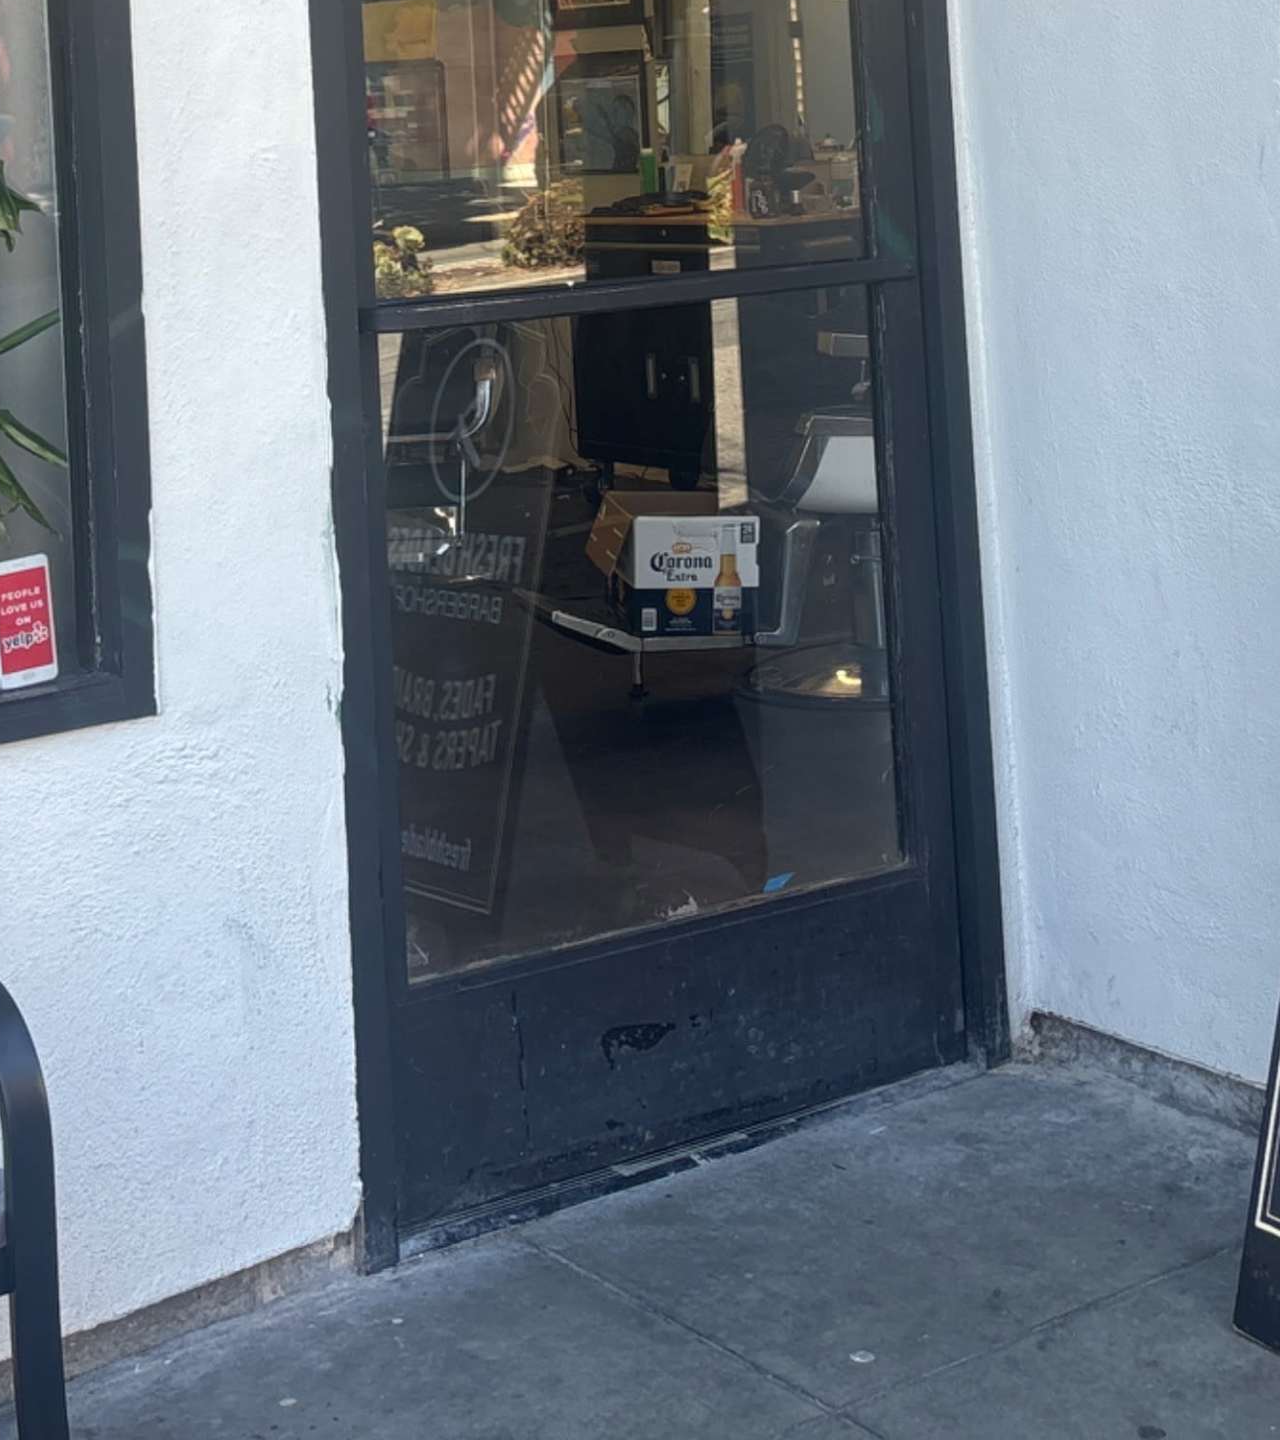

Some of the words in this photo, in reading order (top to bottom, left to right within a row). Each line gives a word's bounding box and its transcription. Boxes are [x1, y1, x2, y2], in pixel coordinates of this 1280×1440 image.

[650, 551, 713, 573] Corona
[666, 569, 699, 582] Extra
[1, 586, 40, 602] PEOPLE
[0, 603, 28, 616] LOVE
[30, 599, 44, 610] US
[15, 616, 32, 627] ON
[3, 631, 33, 653] yelp
